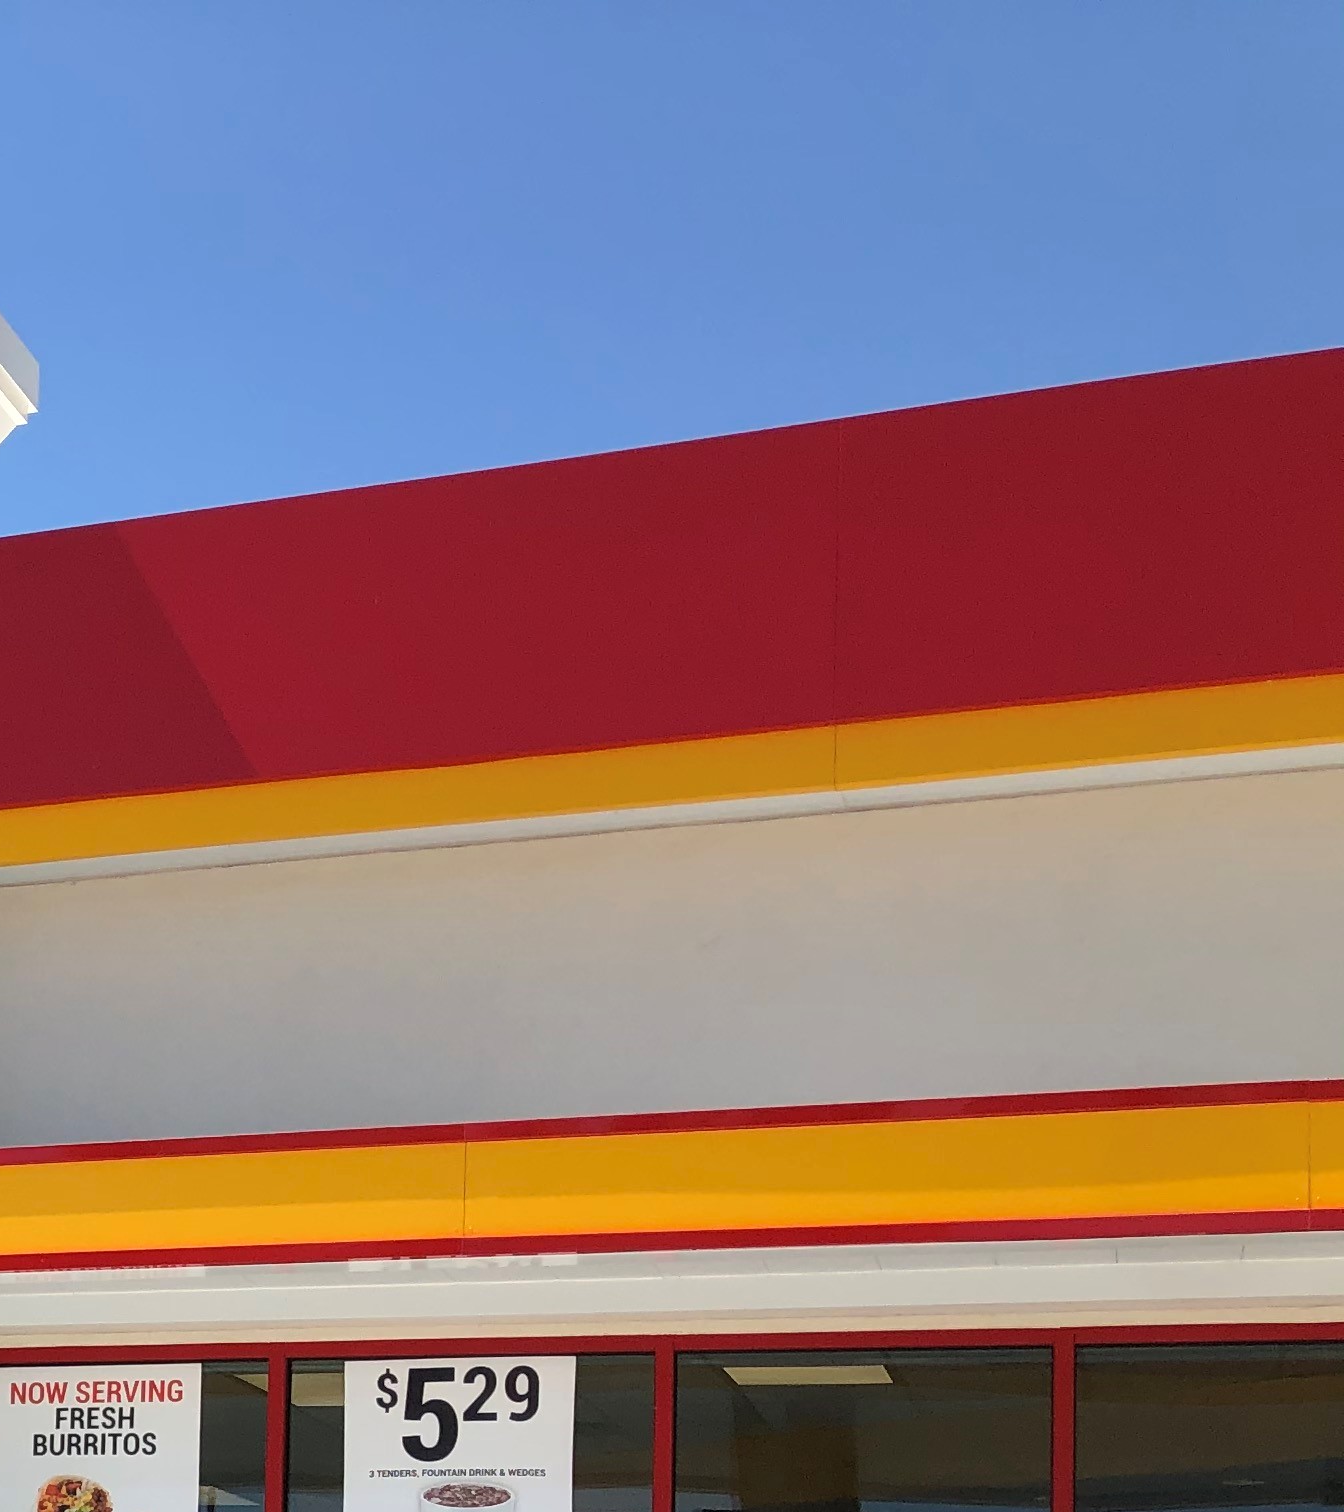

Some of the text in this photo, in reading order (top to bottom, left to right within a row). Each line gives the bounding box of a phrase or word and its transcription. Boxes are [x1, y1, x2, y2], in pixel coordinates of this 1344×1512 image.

[10, 1380, 184, 1405] NOW SERVING
[55, 1407, 135, 1429] FRESH
[33, 1433, 157, 1456] BURRITOS
[369, 1468, 547, 1478] 3 TENDERS, FOUNTAIN DRINK & WEDGES
